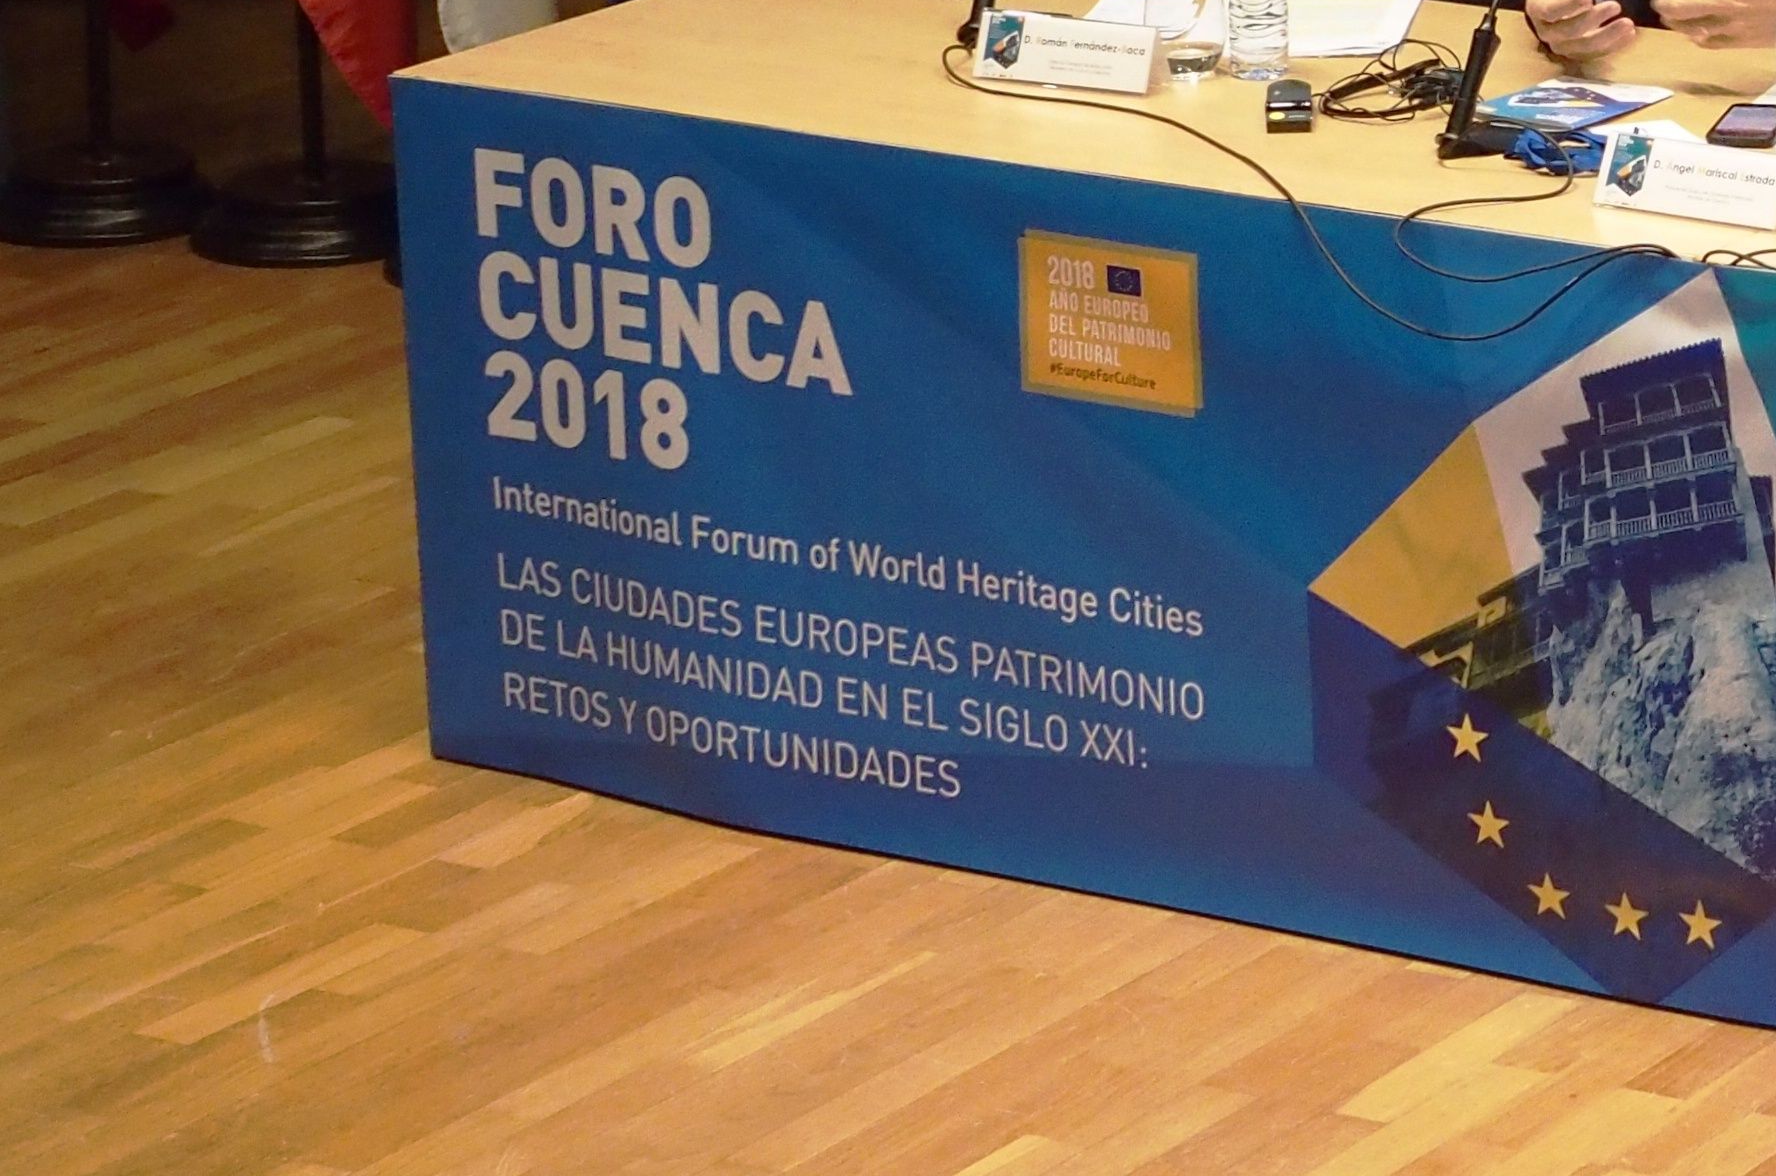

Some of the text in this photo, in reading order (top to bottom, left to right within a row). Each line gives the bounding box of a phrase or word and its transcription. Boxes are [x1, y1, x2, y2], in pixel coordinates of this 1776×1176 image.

[474, 147, 711, 268] FORO
[479, 250, 853, 396] CUENCA
[1048, 255, 1095, 290] 2018
[1050, 313, 1171, 351] DEL PATRIMONIO
[1084, 295, 1149, 324] EUROPEO
[485, 350, 689, 470] 2018
[1050, 338, 1121, 367] CULTURAL
[1050, 362, 1157, 390] #EuropeForCulture
[493, 476, 1204, 637] International Forum of World Heritage Cities
[497, 553, 1204, 721] LAS CIUDADES EUROPEAS PATRIMONIO
[501, 609, 1148, 769] DE LA HUMANIDAD EN EL SIGLO XXI:
[503, 671, 961, 798] RETOS Y OPORTUNIDADES
